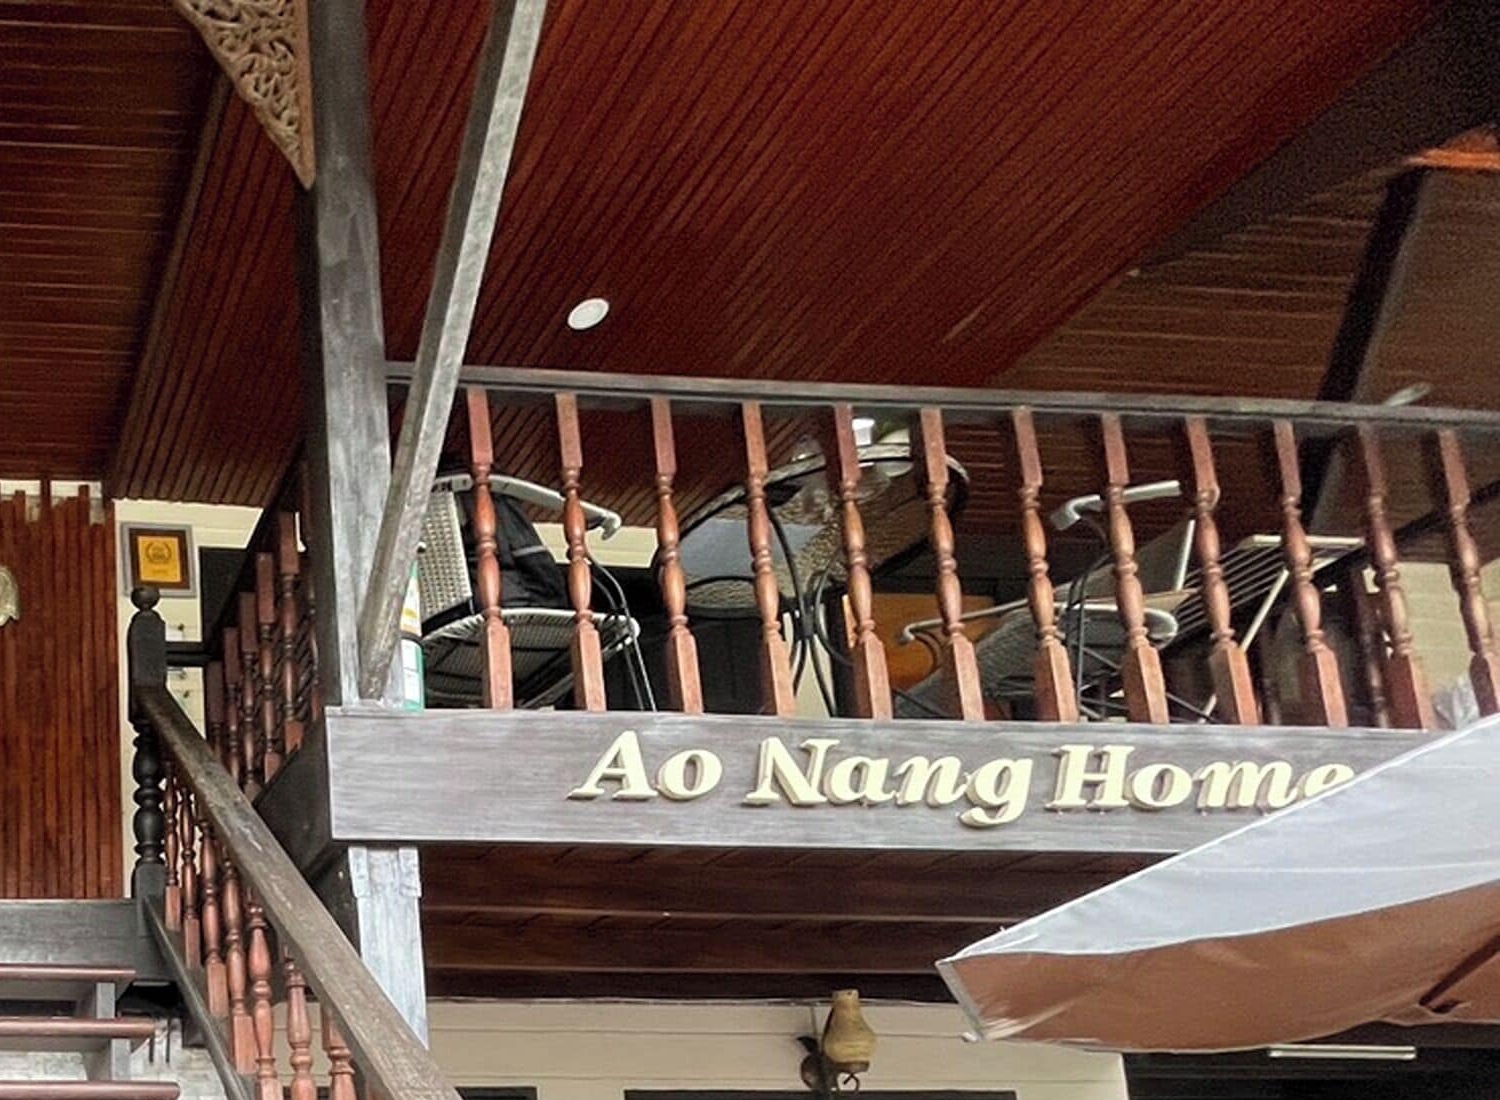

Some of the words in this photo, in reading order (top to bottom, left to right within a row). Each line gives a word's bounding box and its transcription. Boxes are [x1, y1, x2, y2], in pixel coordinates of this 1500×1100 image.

[566, 730, 723, 800] Ao
[744, 736, 1034, 829] Nang
[1044, 744, 1355, 812] Home
